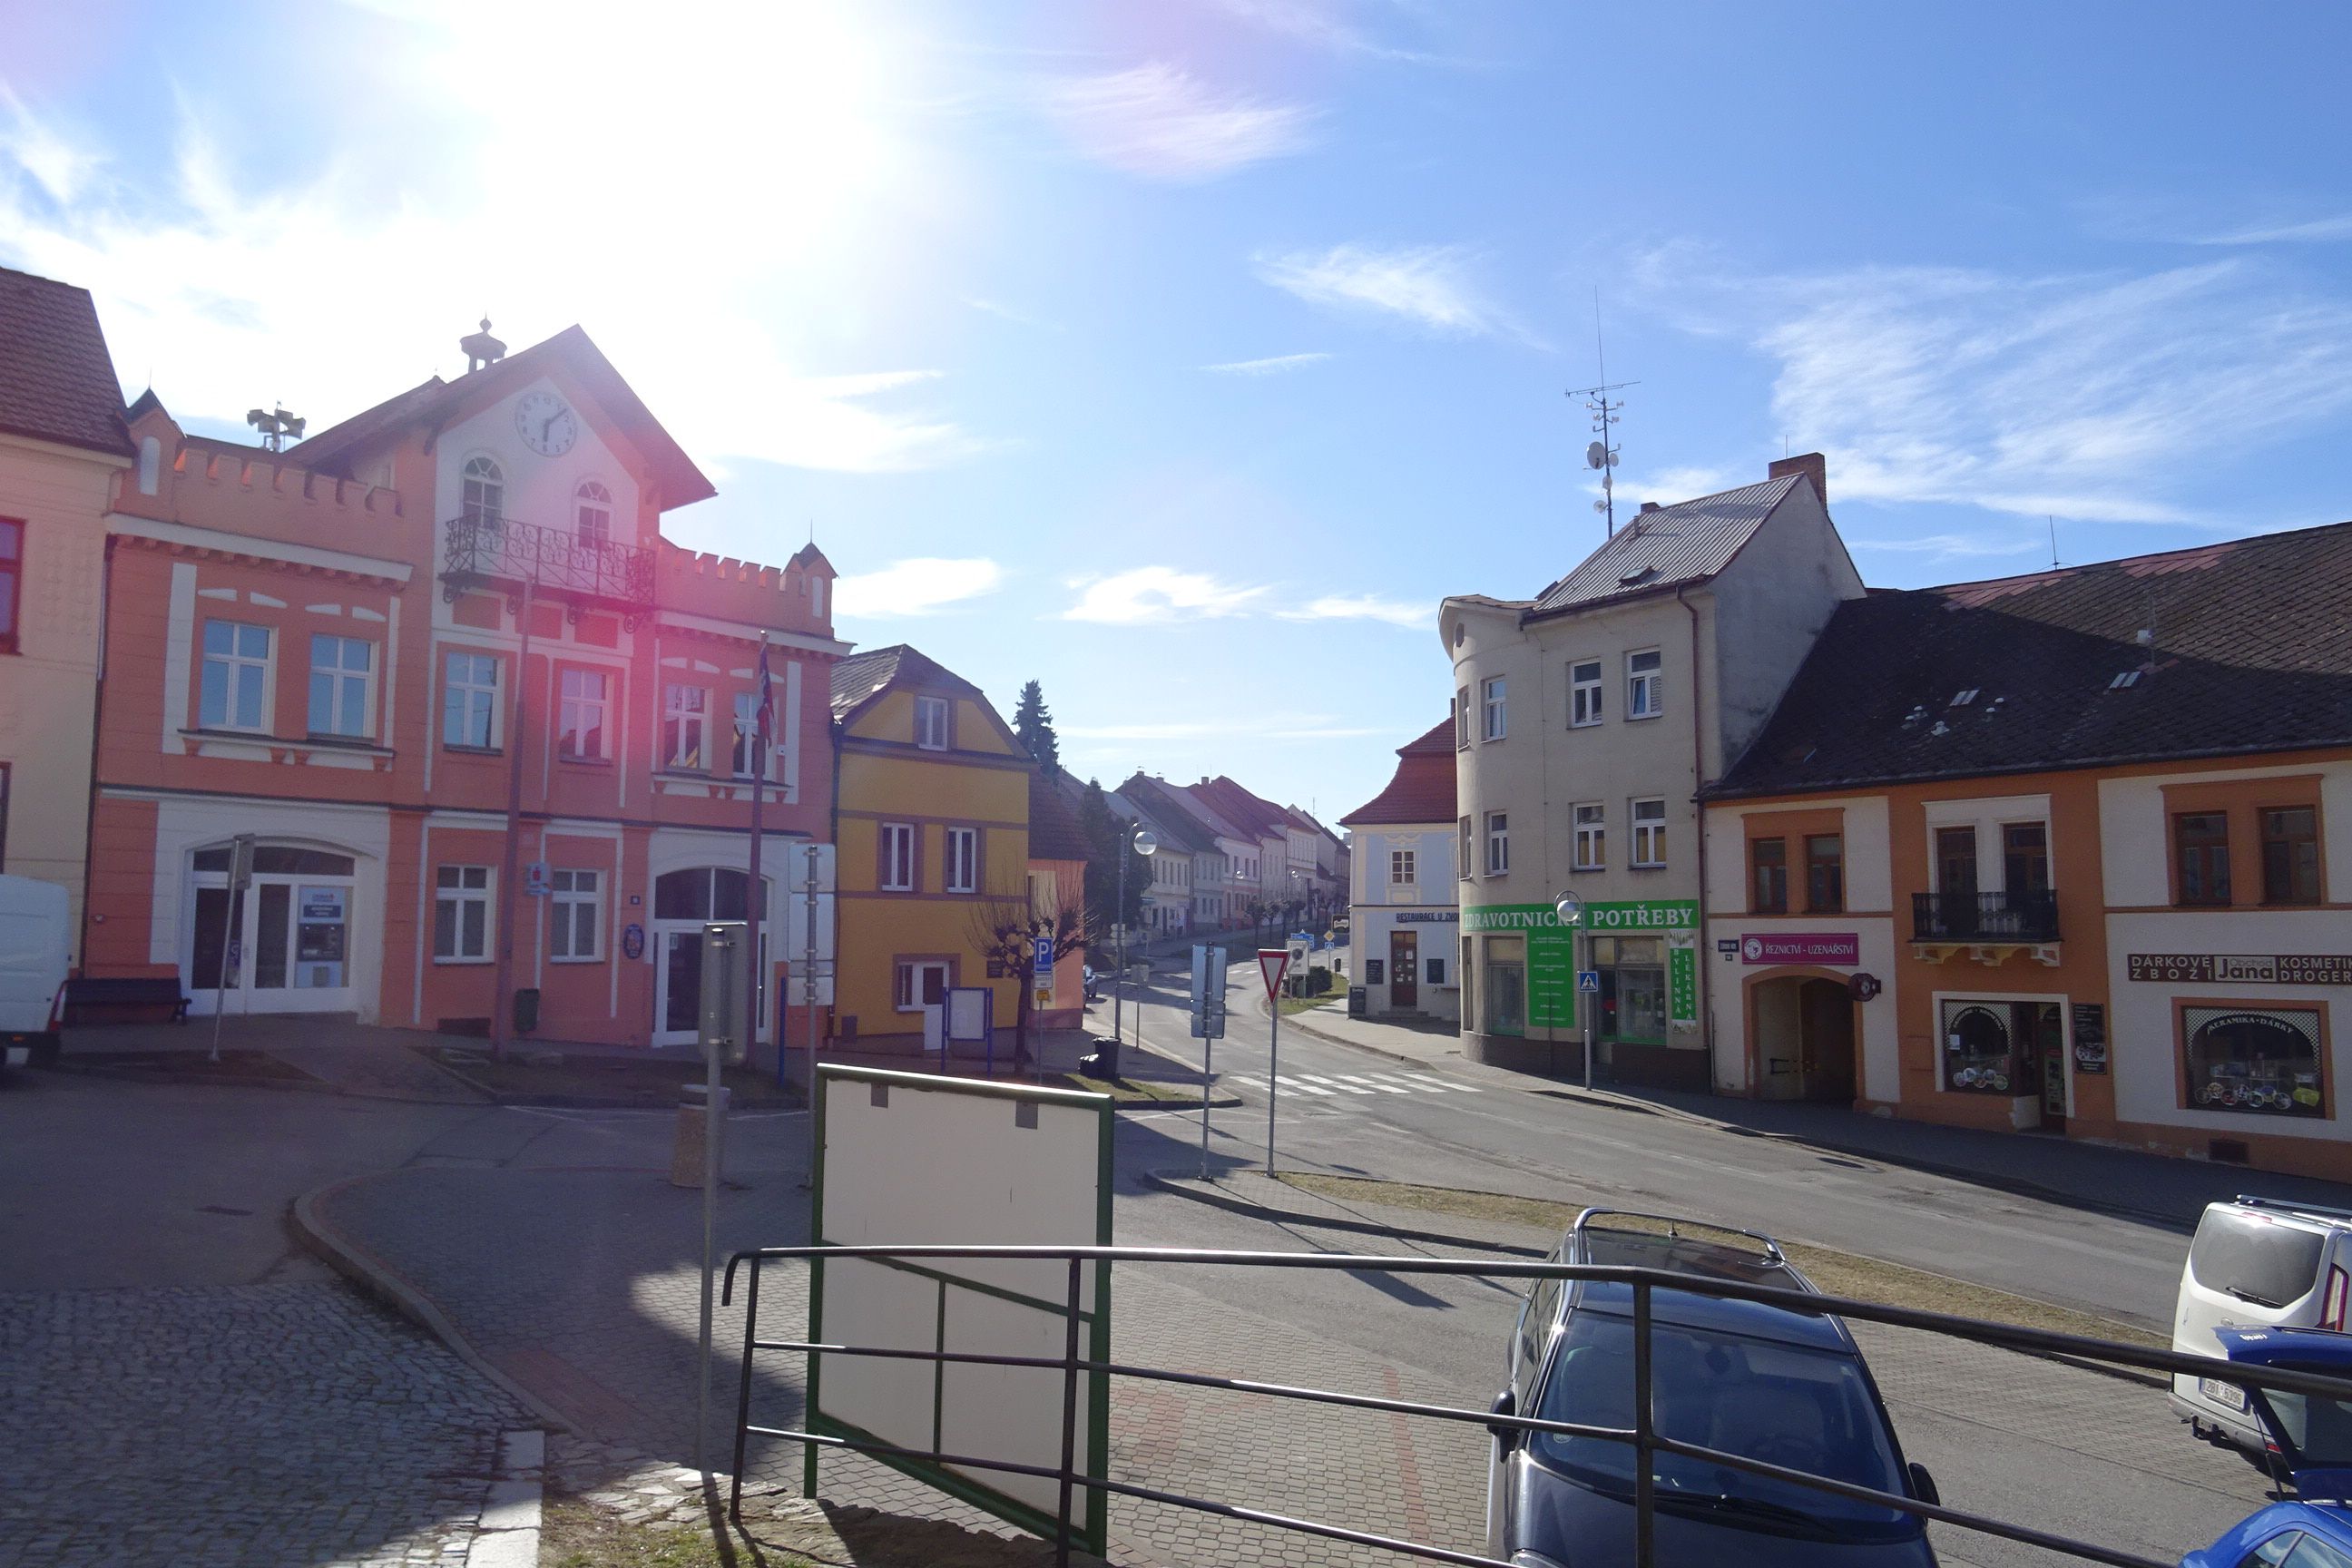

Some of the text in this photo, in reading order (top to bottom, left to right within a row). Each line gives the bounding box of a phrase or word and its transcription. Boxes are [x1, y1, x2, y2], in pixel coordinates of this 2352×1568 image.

[1592, 904, 1693, 926] POTŘEBY
[1038, 941, 1049, 962] P
[1765, 943, 1801, 955] ŘEZNICTVÍ
[1808, 942, 1854, 955] UZENÁŘSTVÍ
[2132, 955, 2211, 967] DÁRKOVÉ
[2218, 958, 2274, 979] Jana
[2132, 967, 2212, 980] ZBOŽÍ
